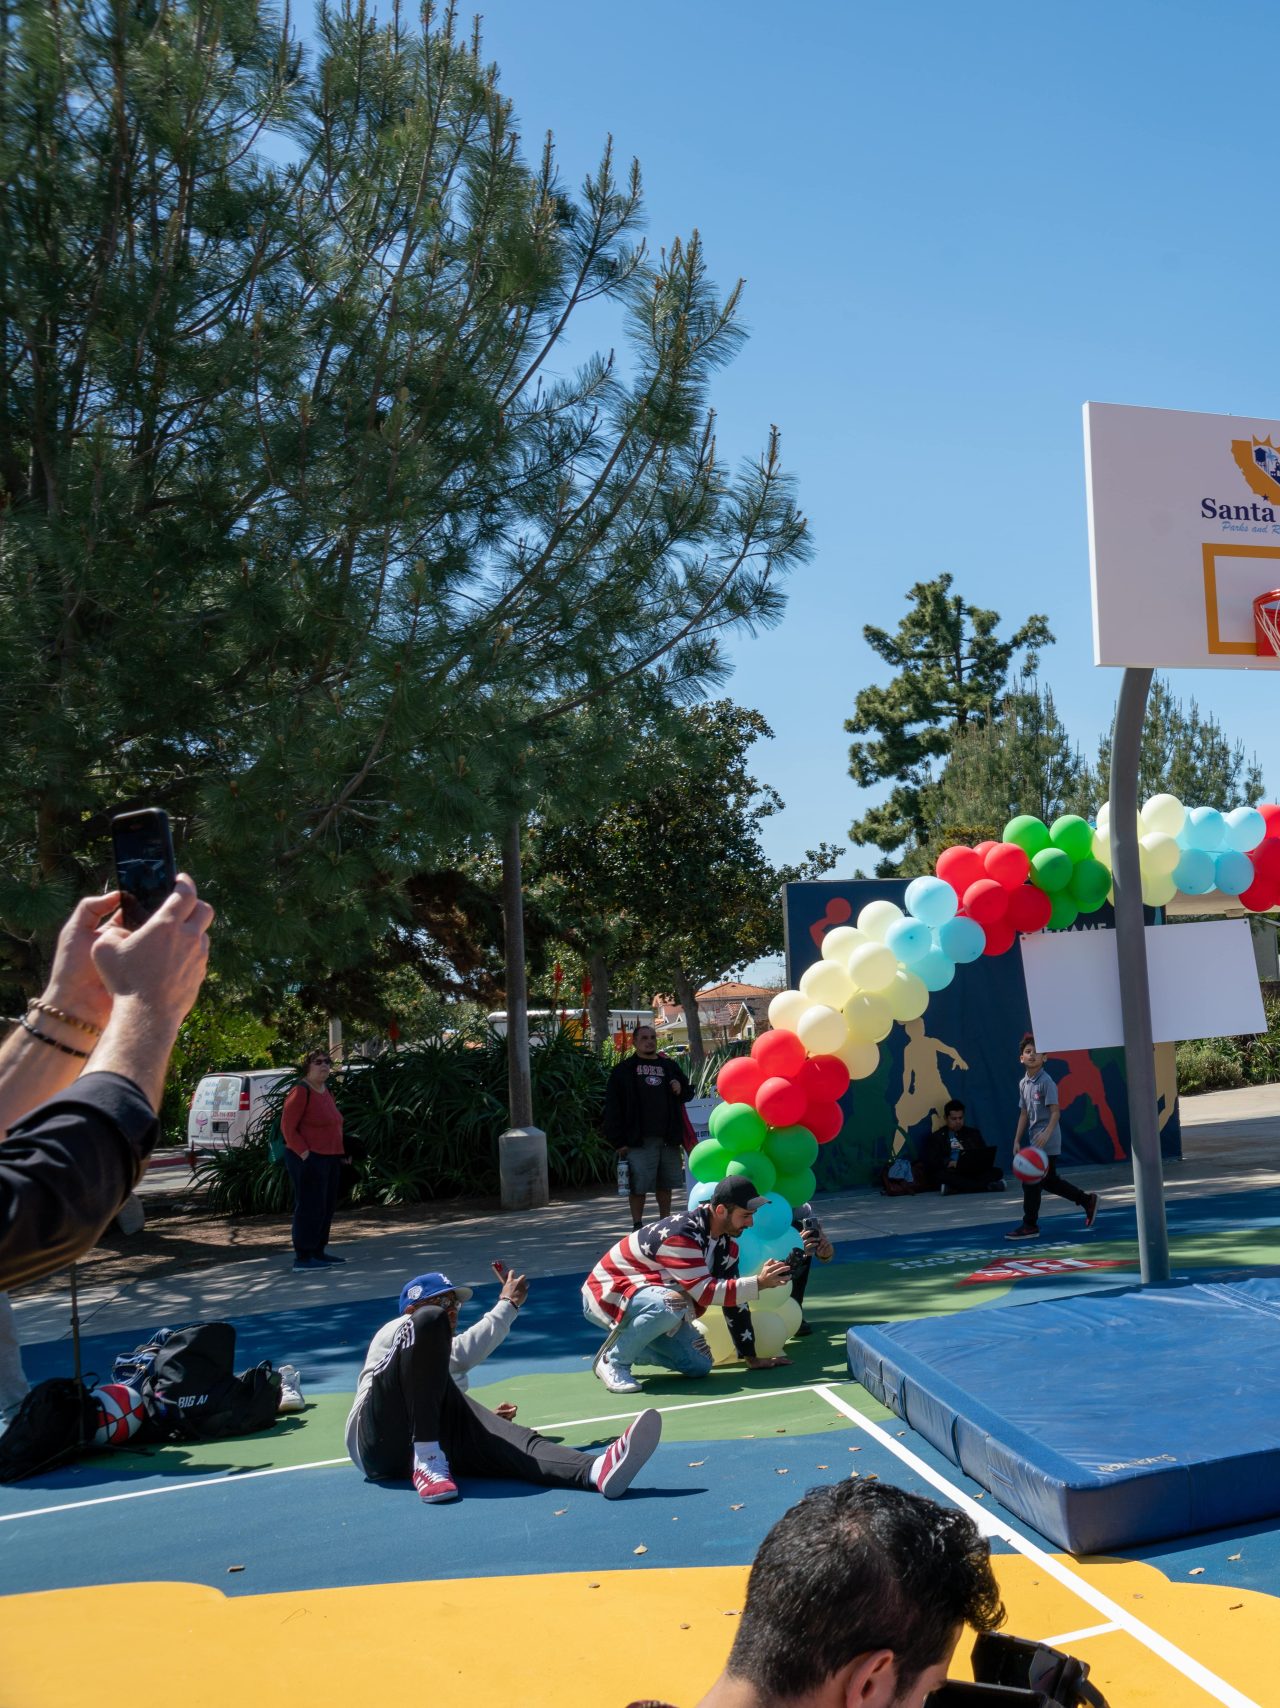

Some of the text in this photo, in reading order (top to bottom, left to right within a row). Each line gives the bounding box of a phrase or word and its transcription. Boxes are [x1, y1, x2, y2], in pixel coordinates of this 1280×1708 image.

[1201, 497, 1276, 523] Santa
[1221, 521, 1248, 532] Parks
[1252, 525, 1268, 533] and
[178, 1395, 196, 1408] BIG
